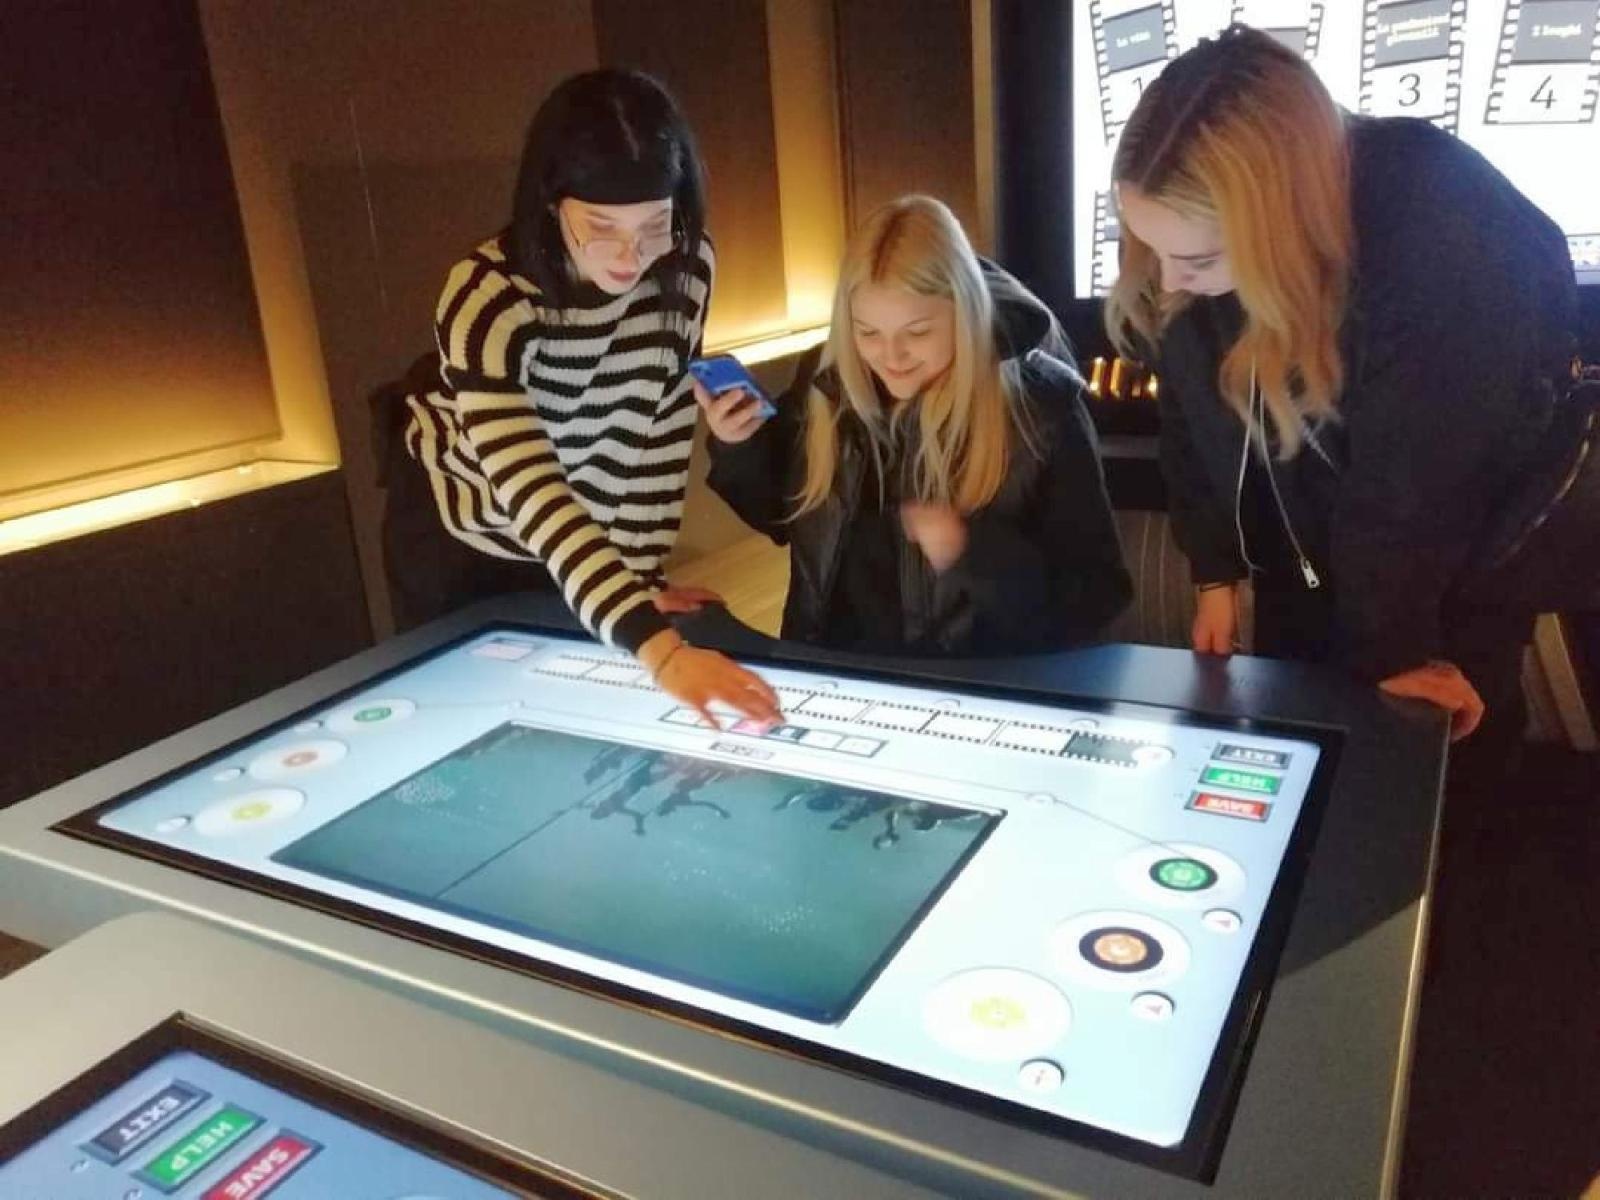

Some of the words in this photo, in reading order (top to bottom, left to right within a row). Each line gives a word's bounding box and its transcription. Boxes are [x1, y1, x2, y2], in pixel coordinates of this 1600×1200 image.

[1399, 73, 1420, 107] 3
[1530, 75, 1557, 108] 4
[120, 1097, 179, 1140] EXIT
[170, 1120, 233, 1170] HELP
[225, 1148, 289, 1199] SAVE
